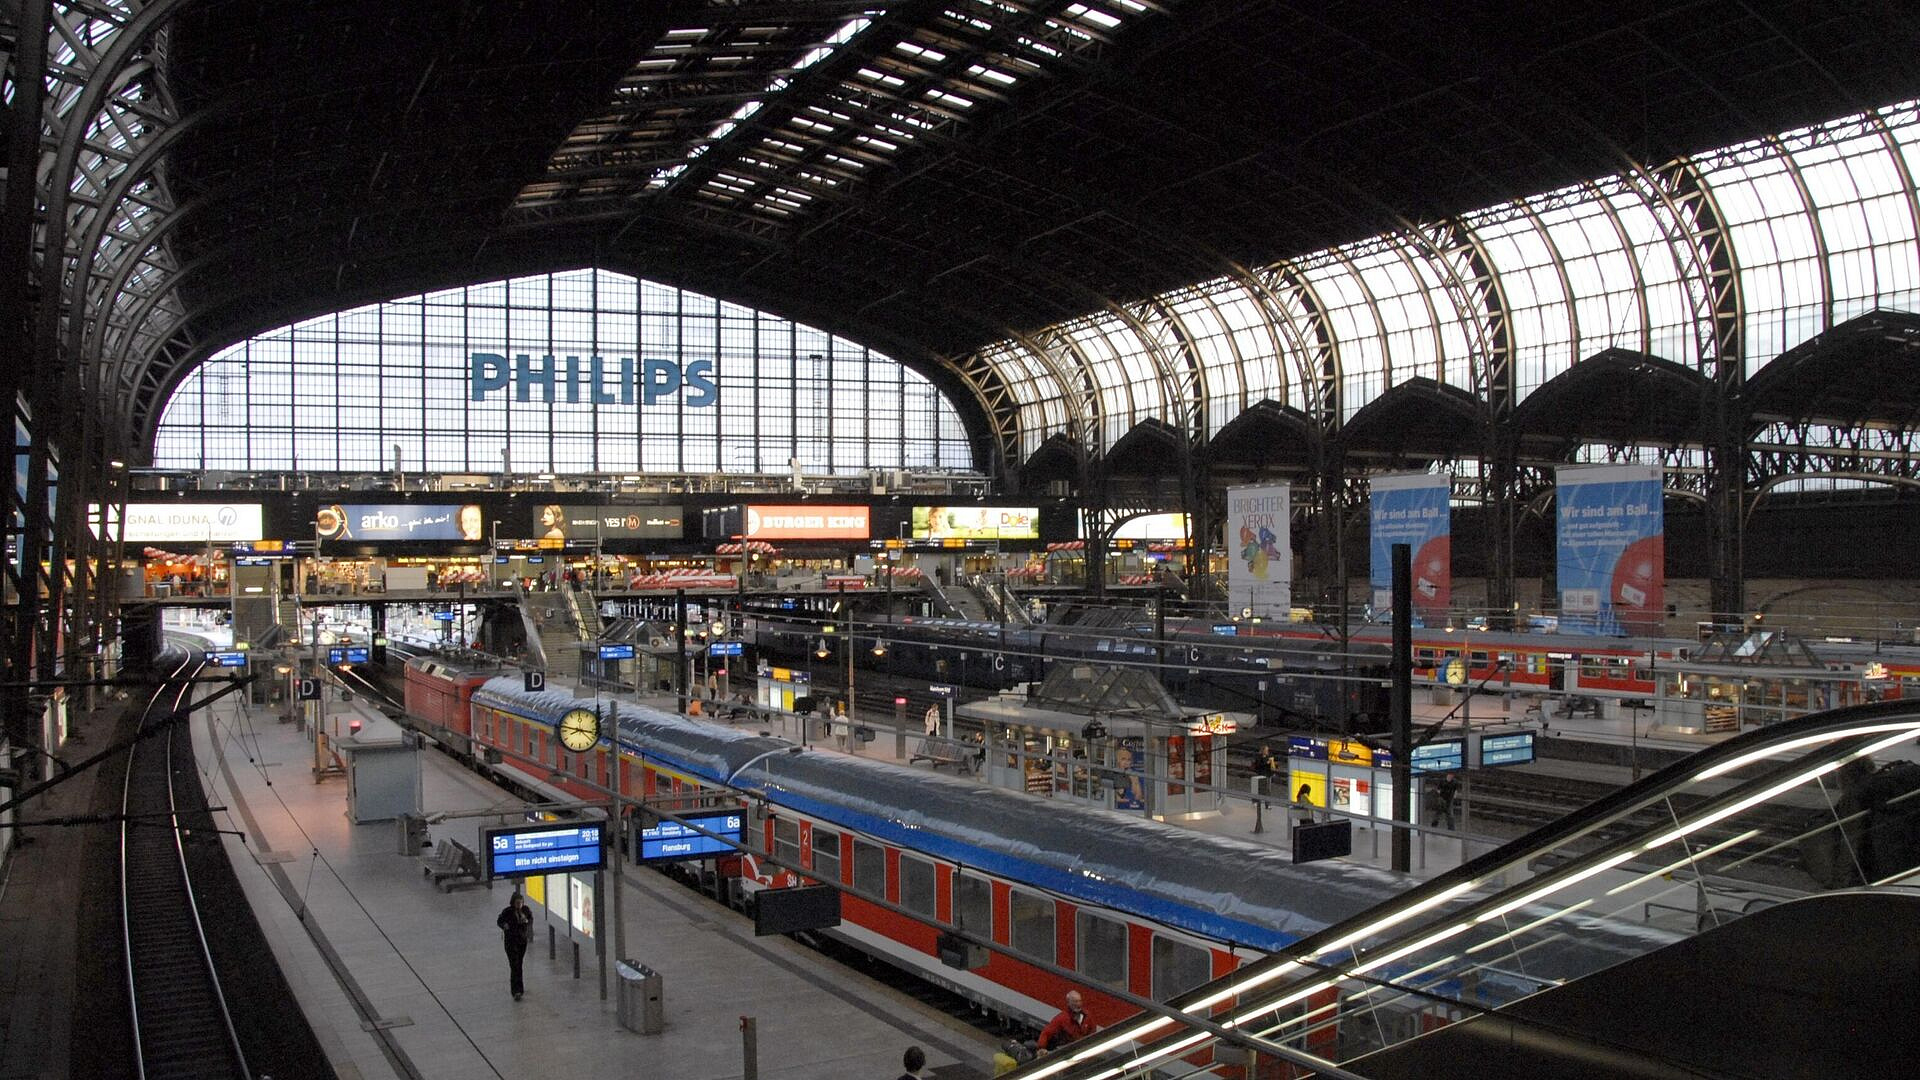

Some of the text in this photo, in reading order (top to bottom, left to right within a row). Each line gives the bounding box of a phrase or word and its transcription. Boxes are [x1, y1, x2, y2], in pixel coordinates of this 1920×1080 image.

[471, 352, 718, 408] PHILIPS
[1233, 496, 1284, 514] BRIGHTER
[1560, 506, 1580, 518] Wir
[1582, 505, 1604, 517] sind
[1606, 506, 1624, 517] am
[1626, 503, 1648, 516] Ball
[168, 514, 210, 525] IDUNA
[361, 511, 399, 529] arko
[1242, 513, 1275, 529] XEROX
[1374, 509, 1386, 521] Wir
[1388, 508, 1407, 520] sind
[1407, 509, 1421, 519] am
[1422, 507, 1439, 518] Ball
[604, 517, 621, 528] YES
[762, 516, 866, 529] BURGER KING
[1190, 648, 1200, 662] C
[995, 656, 1005, 671] C
[531, 673, 543, 688] D
[302, 681, 314, 695] D
[727, 816, 740, 828] 6a
[493, 836, 509, 849] 5a
[803, 830, 808, 846] 2
[662, 843, 691, 852] Flensburg
[515, 854, 579, 867] Bitte nicht einsteigen
